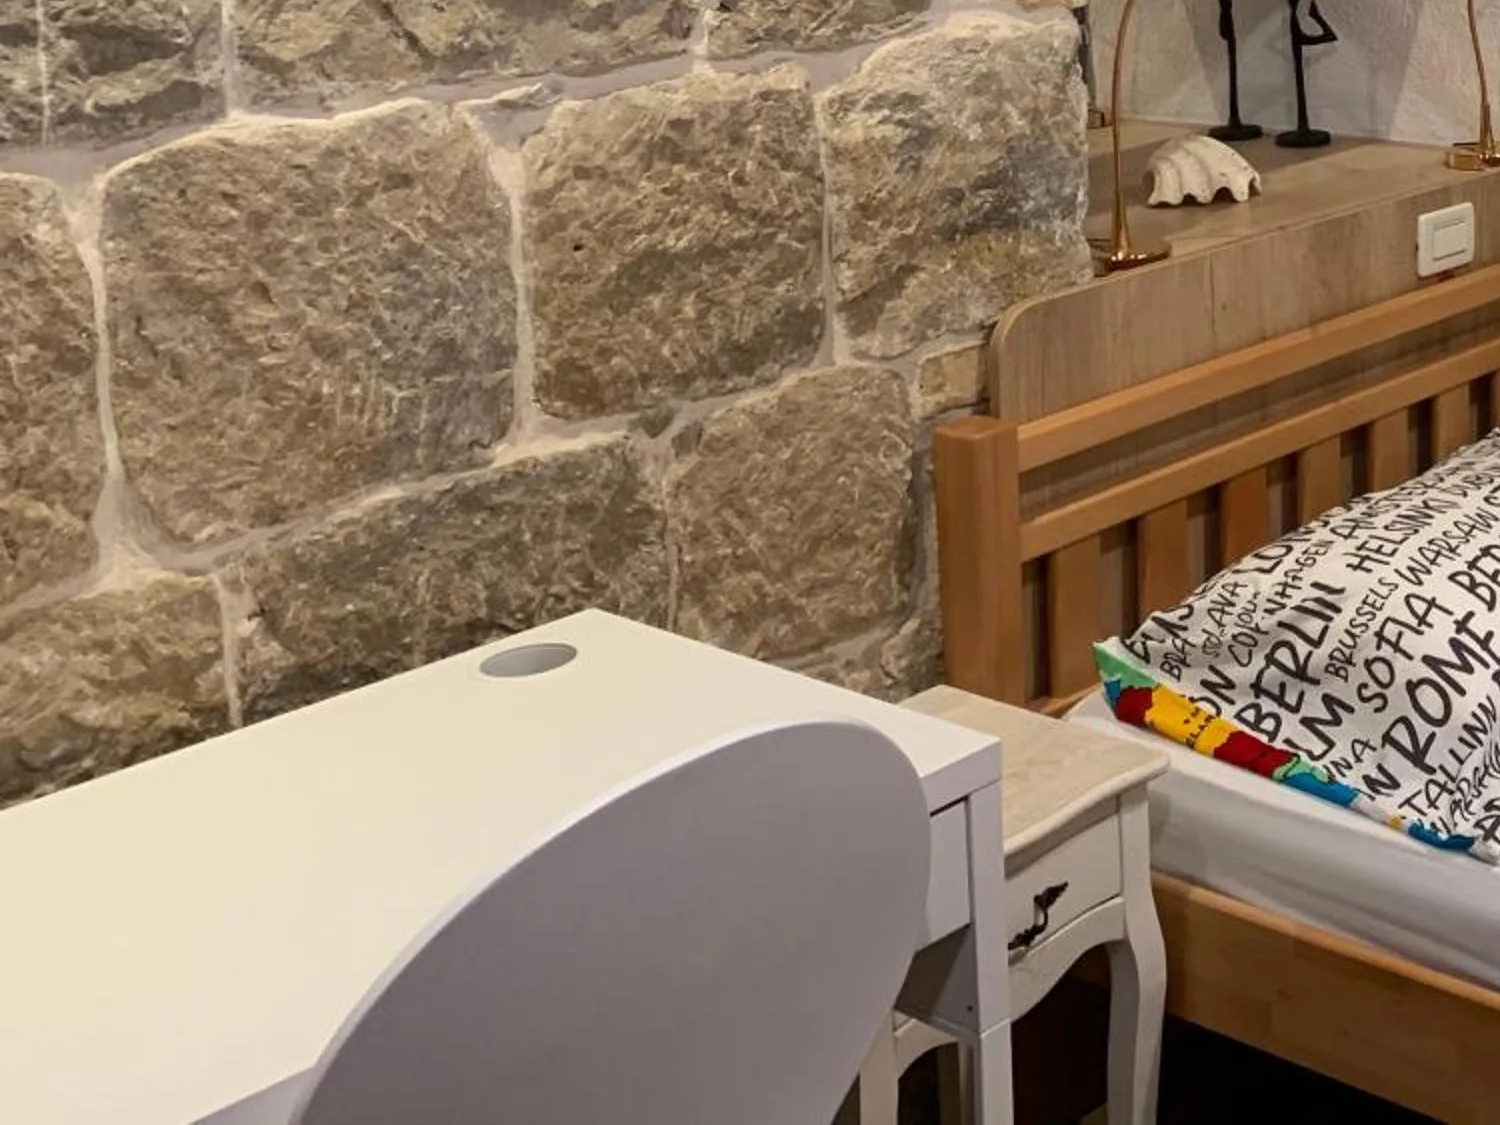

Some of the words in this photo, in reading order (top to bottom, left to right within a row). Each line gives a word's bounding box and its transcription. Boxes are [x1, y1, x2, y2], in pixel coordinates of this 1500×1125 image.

[1394, 509, 1499, 587] WARSAW
[1234, 582, 1346, 742] BERLIN
[1324, 577, 1399, 682] BRUSSELS
[1358, 592, 1453, 713] SOFIA
[1399, 697, 1497, 819] TALLINN
